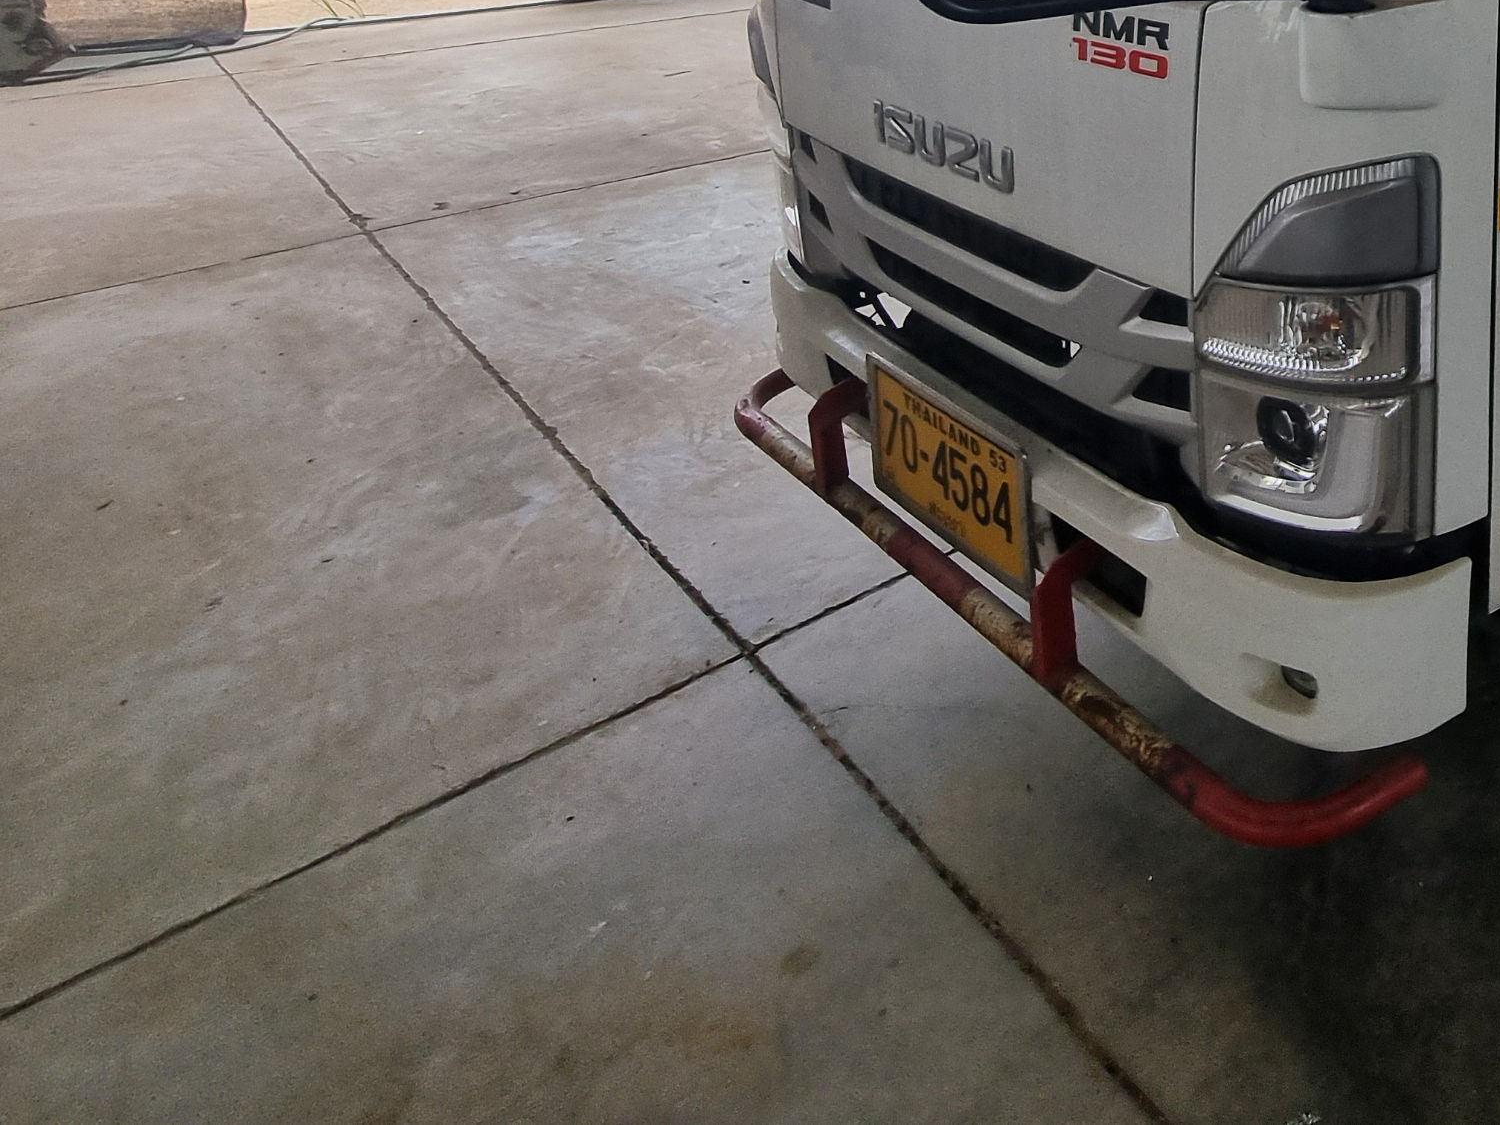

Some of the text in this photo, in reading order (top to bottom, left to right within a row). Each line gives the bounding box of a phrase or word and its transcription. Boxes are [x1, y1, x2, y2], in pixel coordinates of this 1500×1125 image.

[1072, 10, 1170, 51] NMR
[1072, 37, 1169, 79] 130
[873, 98, 1015, 195] ISUZU
[903, 391, 981, 457] THAILAND
[883, 399, 1014, 545] 70-4584
